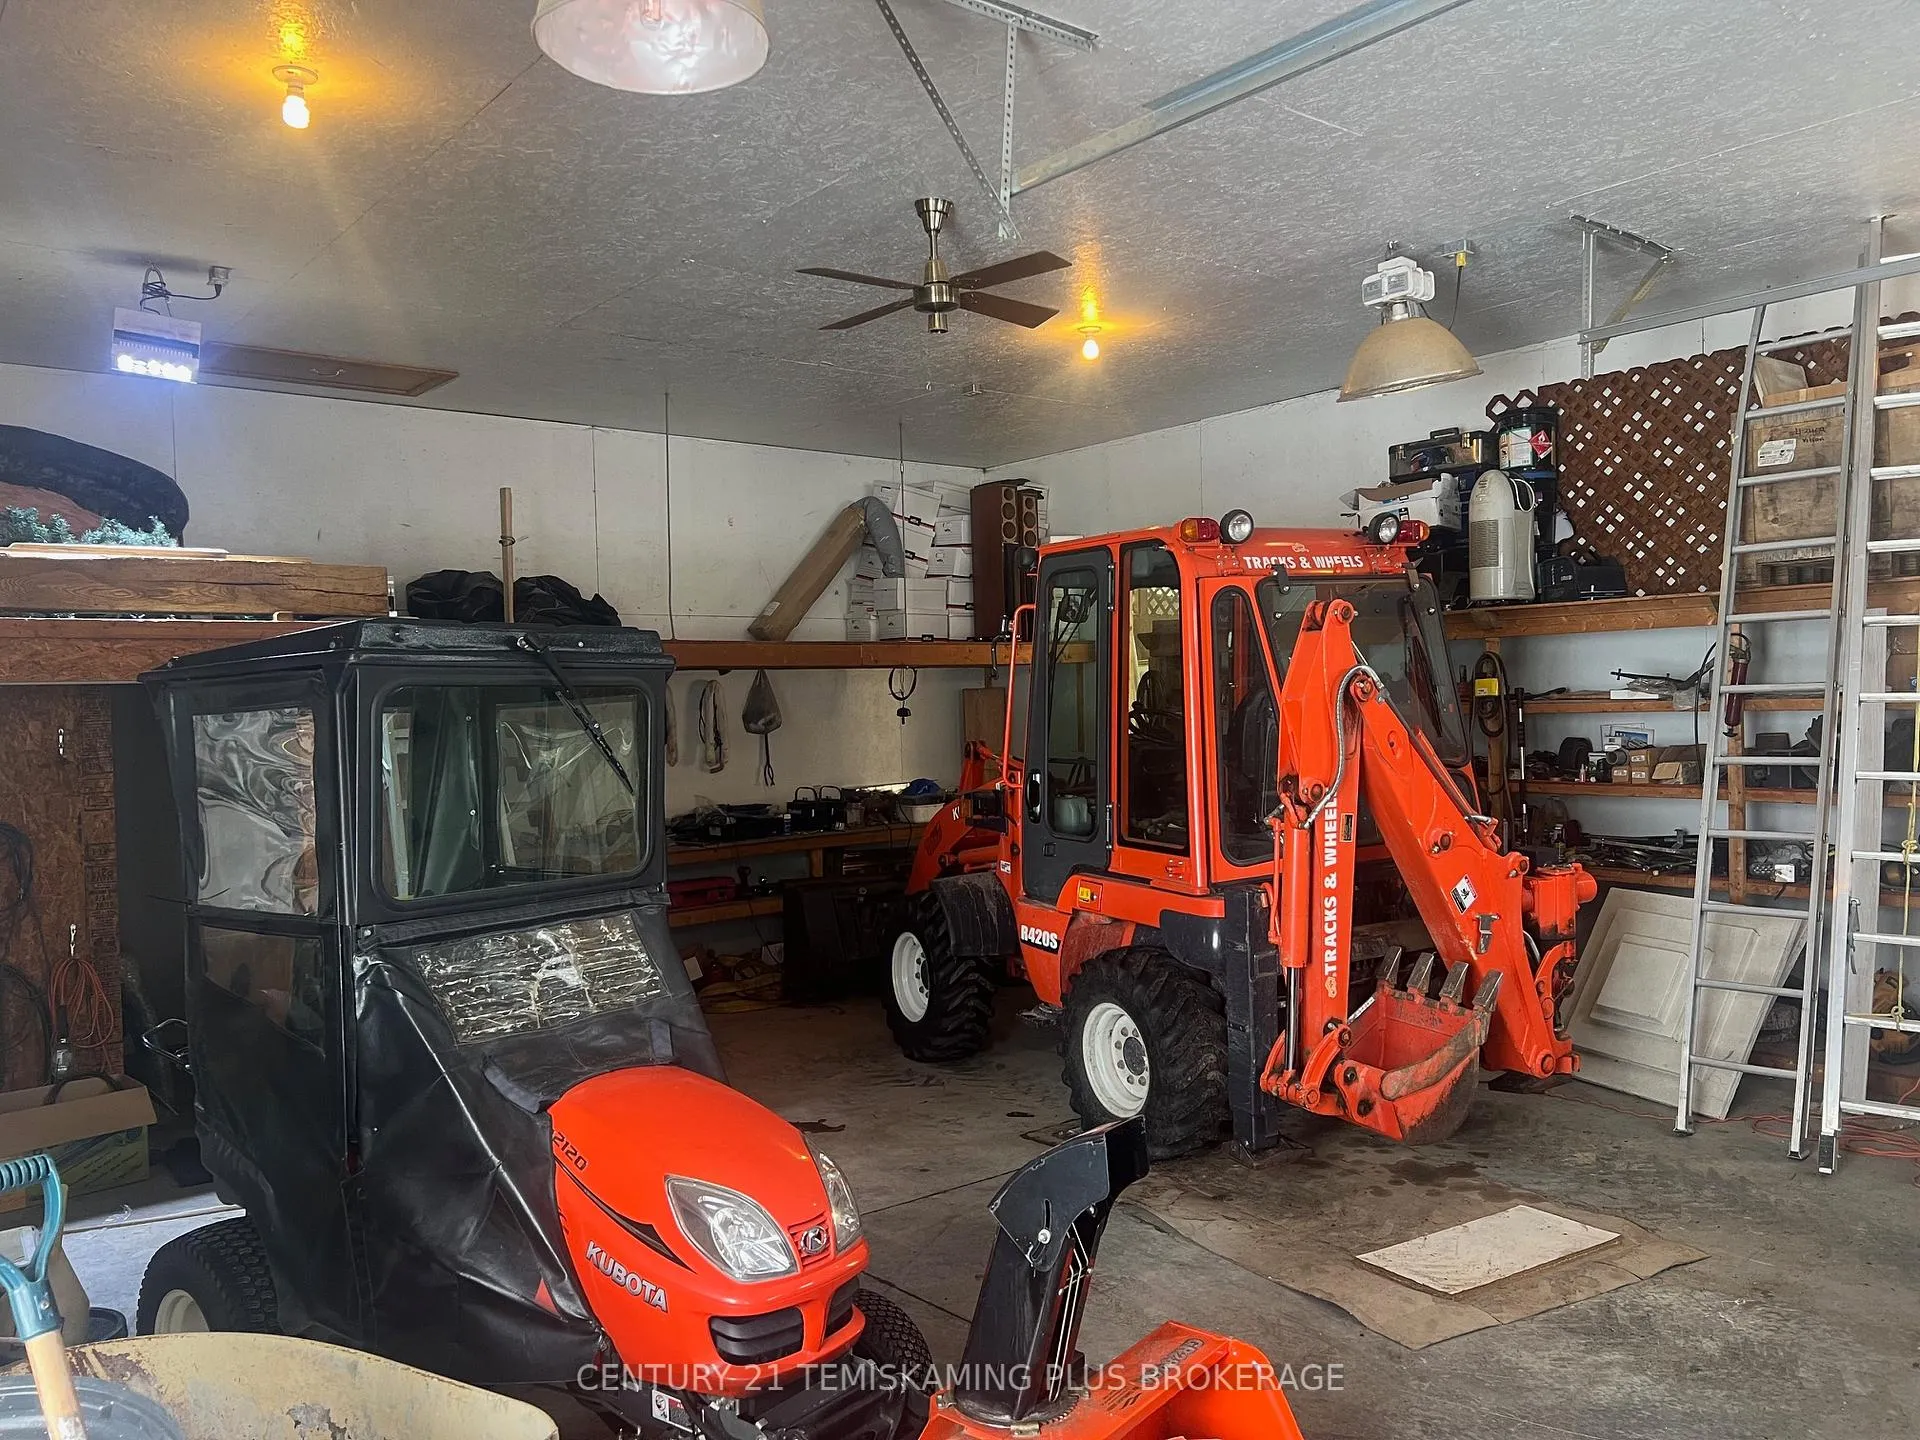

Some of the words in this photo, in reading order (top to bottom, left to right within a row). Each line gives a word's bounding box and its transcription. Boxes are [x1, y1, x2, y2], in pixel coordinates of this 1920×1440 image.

[1243, 556, 1297, 569] TRACKS
[1299, 556, 1311, 569] &
[1312, 555, 1364, 568] WHEELS
[1324, 872, 1337, 890] &
[1020, 925, 1058, 949] R420S
[1324, 895, 1337, 976] TRACKS
[585, 1240, 669, 1313] KUBOTA
